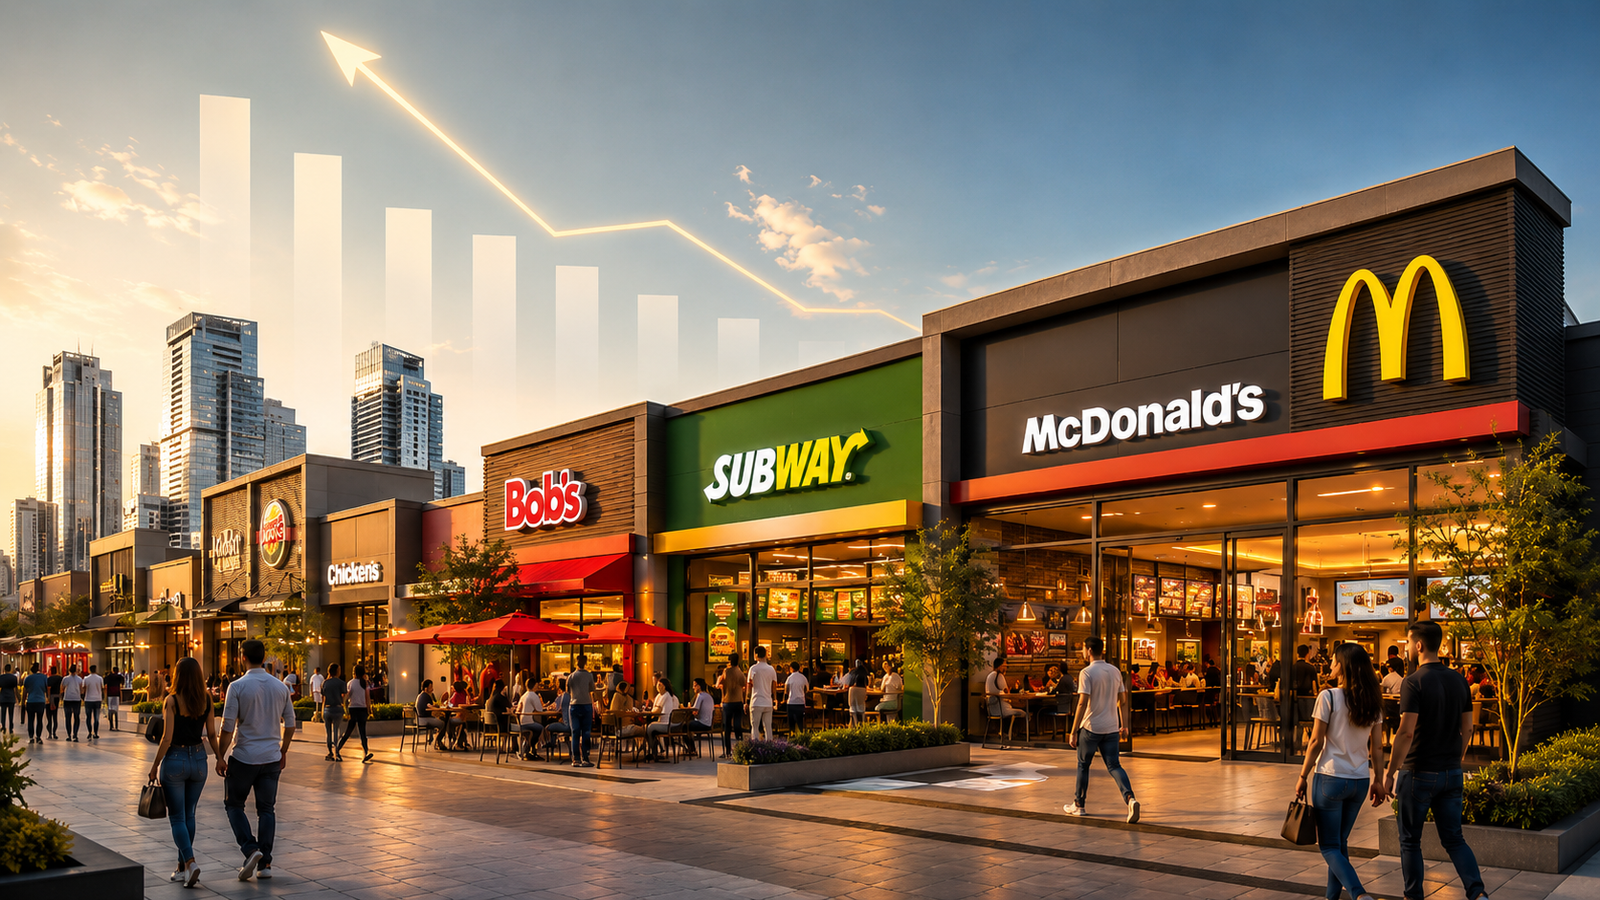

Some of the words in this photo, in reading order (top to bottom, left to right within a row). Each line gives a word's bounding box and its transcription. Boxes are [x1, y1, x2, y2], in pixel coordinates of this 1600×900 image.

[1022, 382, 1265, 454] McDonald's
[703, 427, 869, 503] SUBWAY
[504, 468, 583, 531] Bob's
[327, 560, 380, 585] Chicken's
